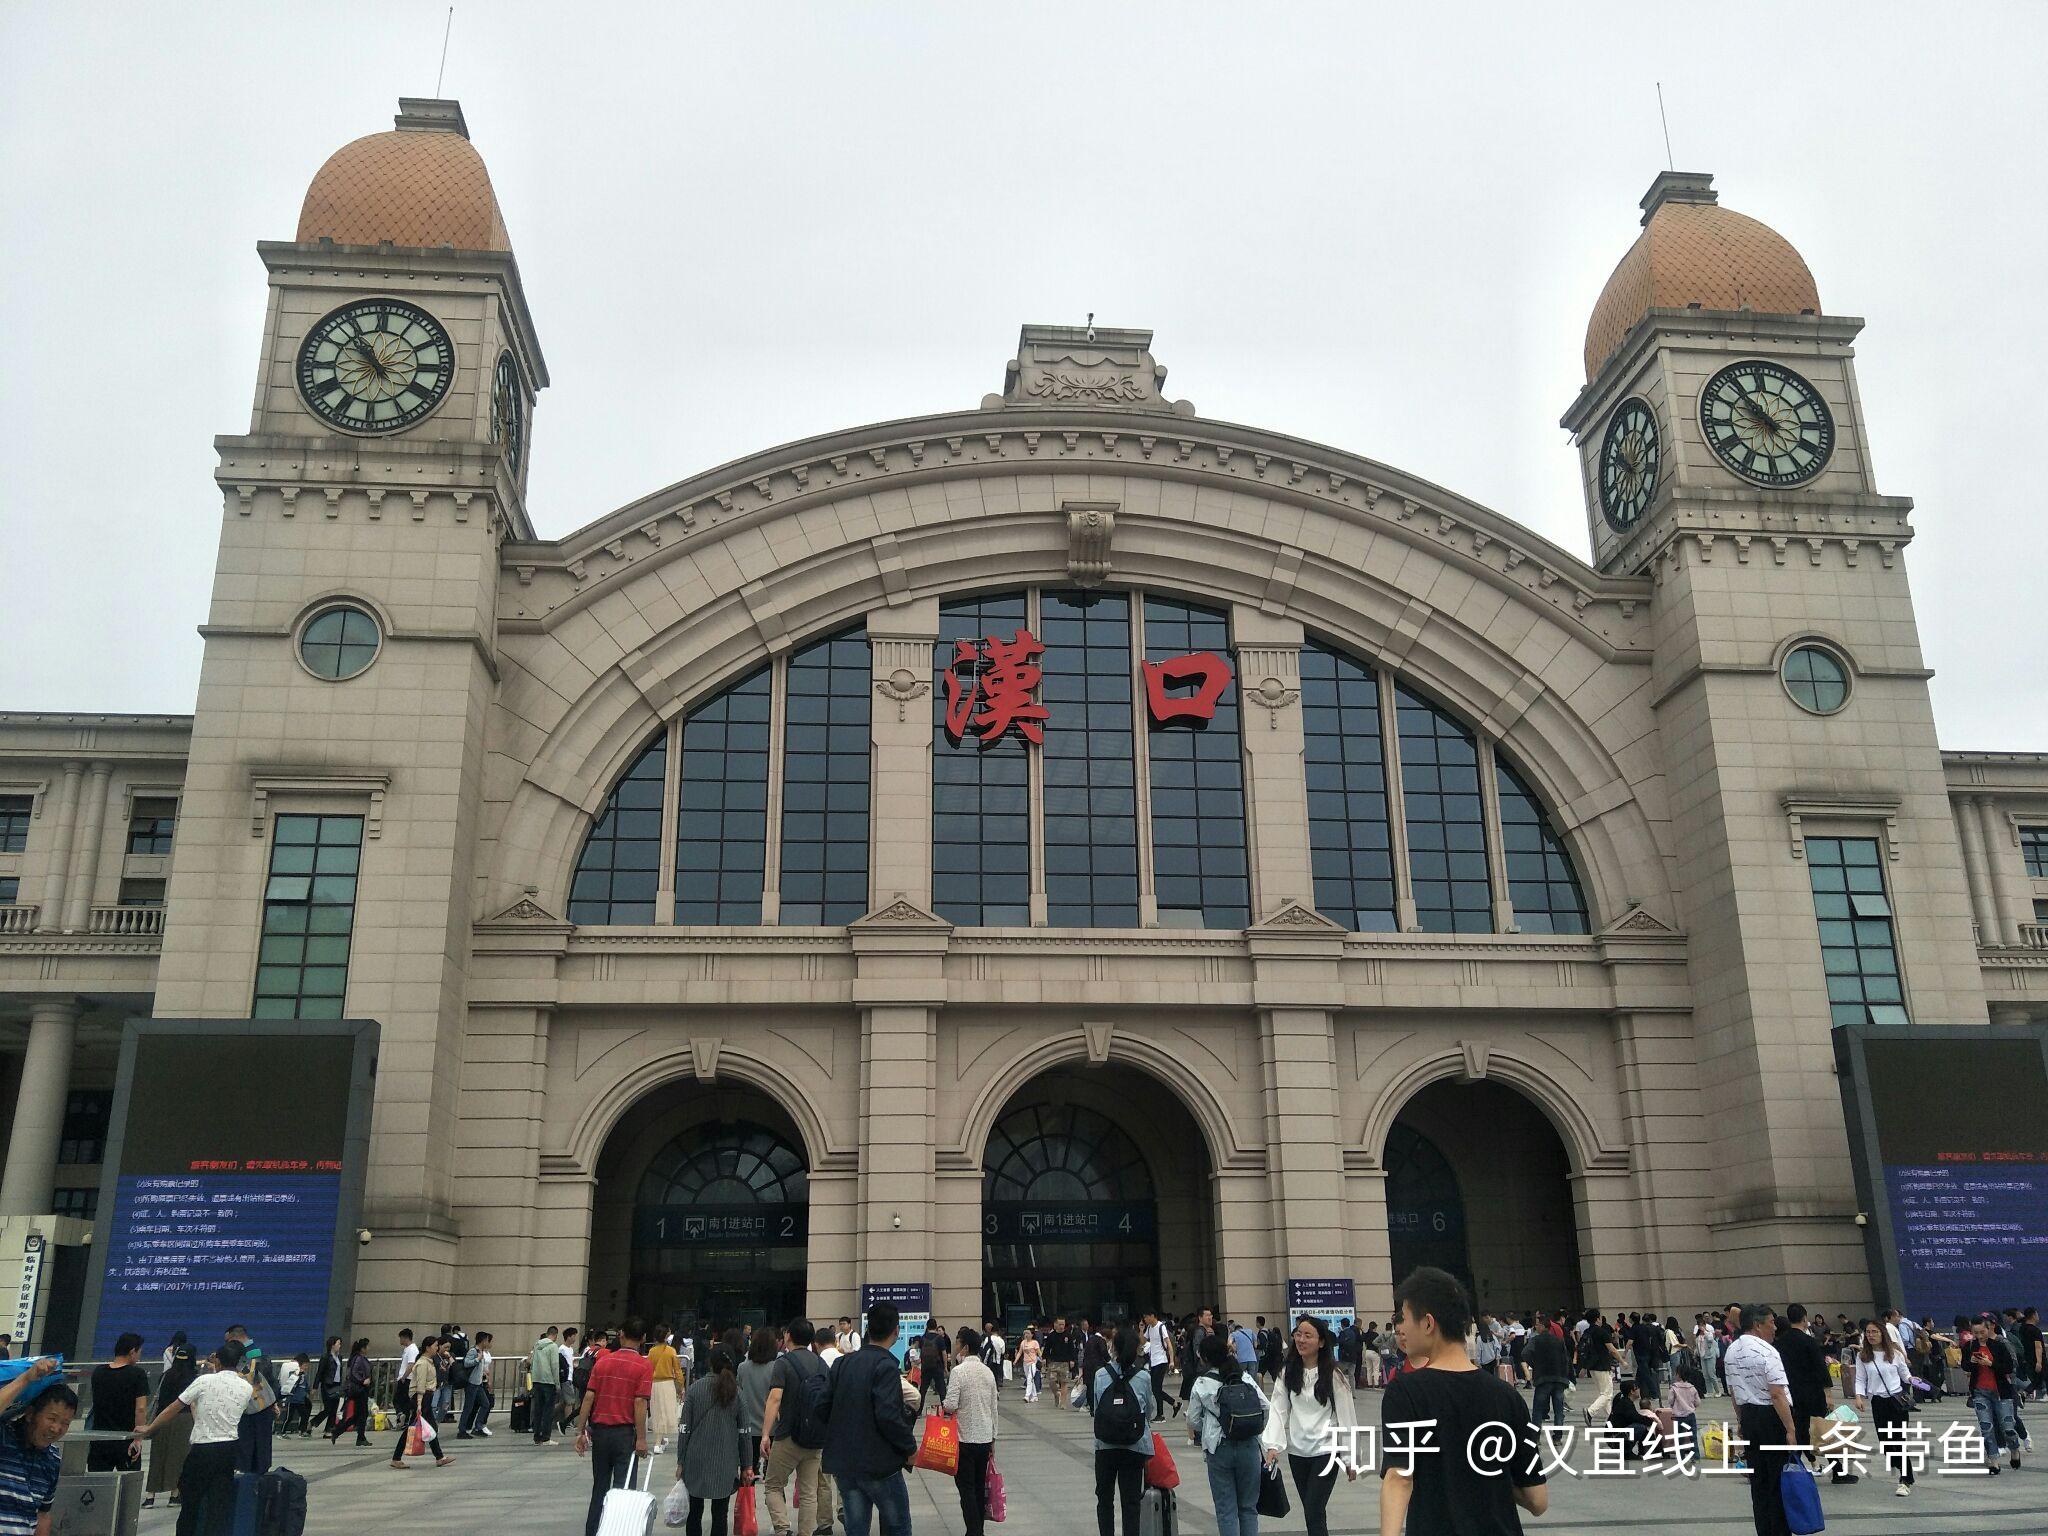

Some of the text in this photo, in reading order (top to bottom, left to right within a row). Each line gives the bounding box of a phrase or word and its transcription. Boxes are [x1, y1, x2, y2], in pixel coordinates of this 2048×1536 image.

[944, 630, 1232, 745] 漢口
[656, 1217, 666, 1239] 1
[709, 1217, 765, 1230] 南1进站口
[780, 1216, 794, 1237] 2
[985, 1214, 998, 1234] 3
[1044, 1213, 1098, 1226] 南1进站口
[1119, 1213, 1131, 1233] 4
[1433, 1211, 1446, 1232] 6
[15, 1256, 36, 1338] 临时身份证明办理处
